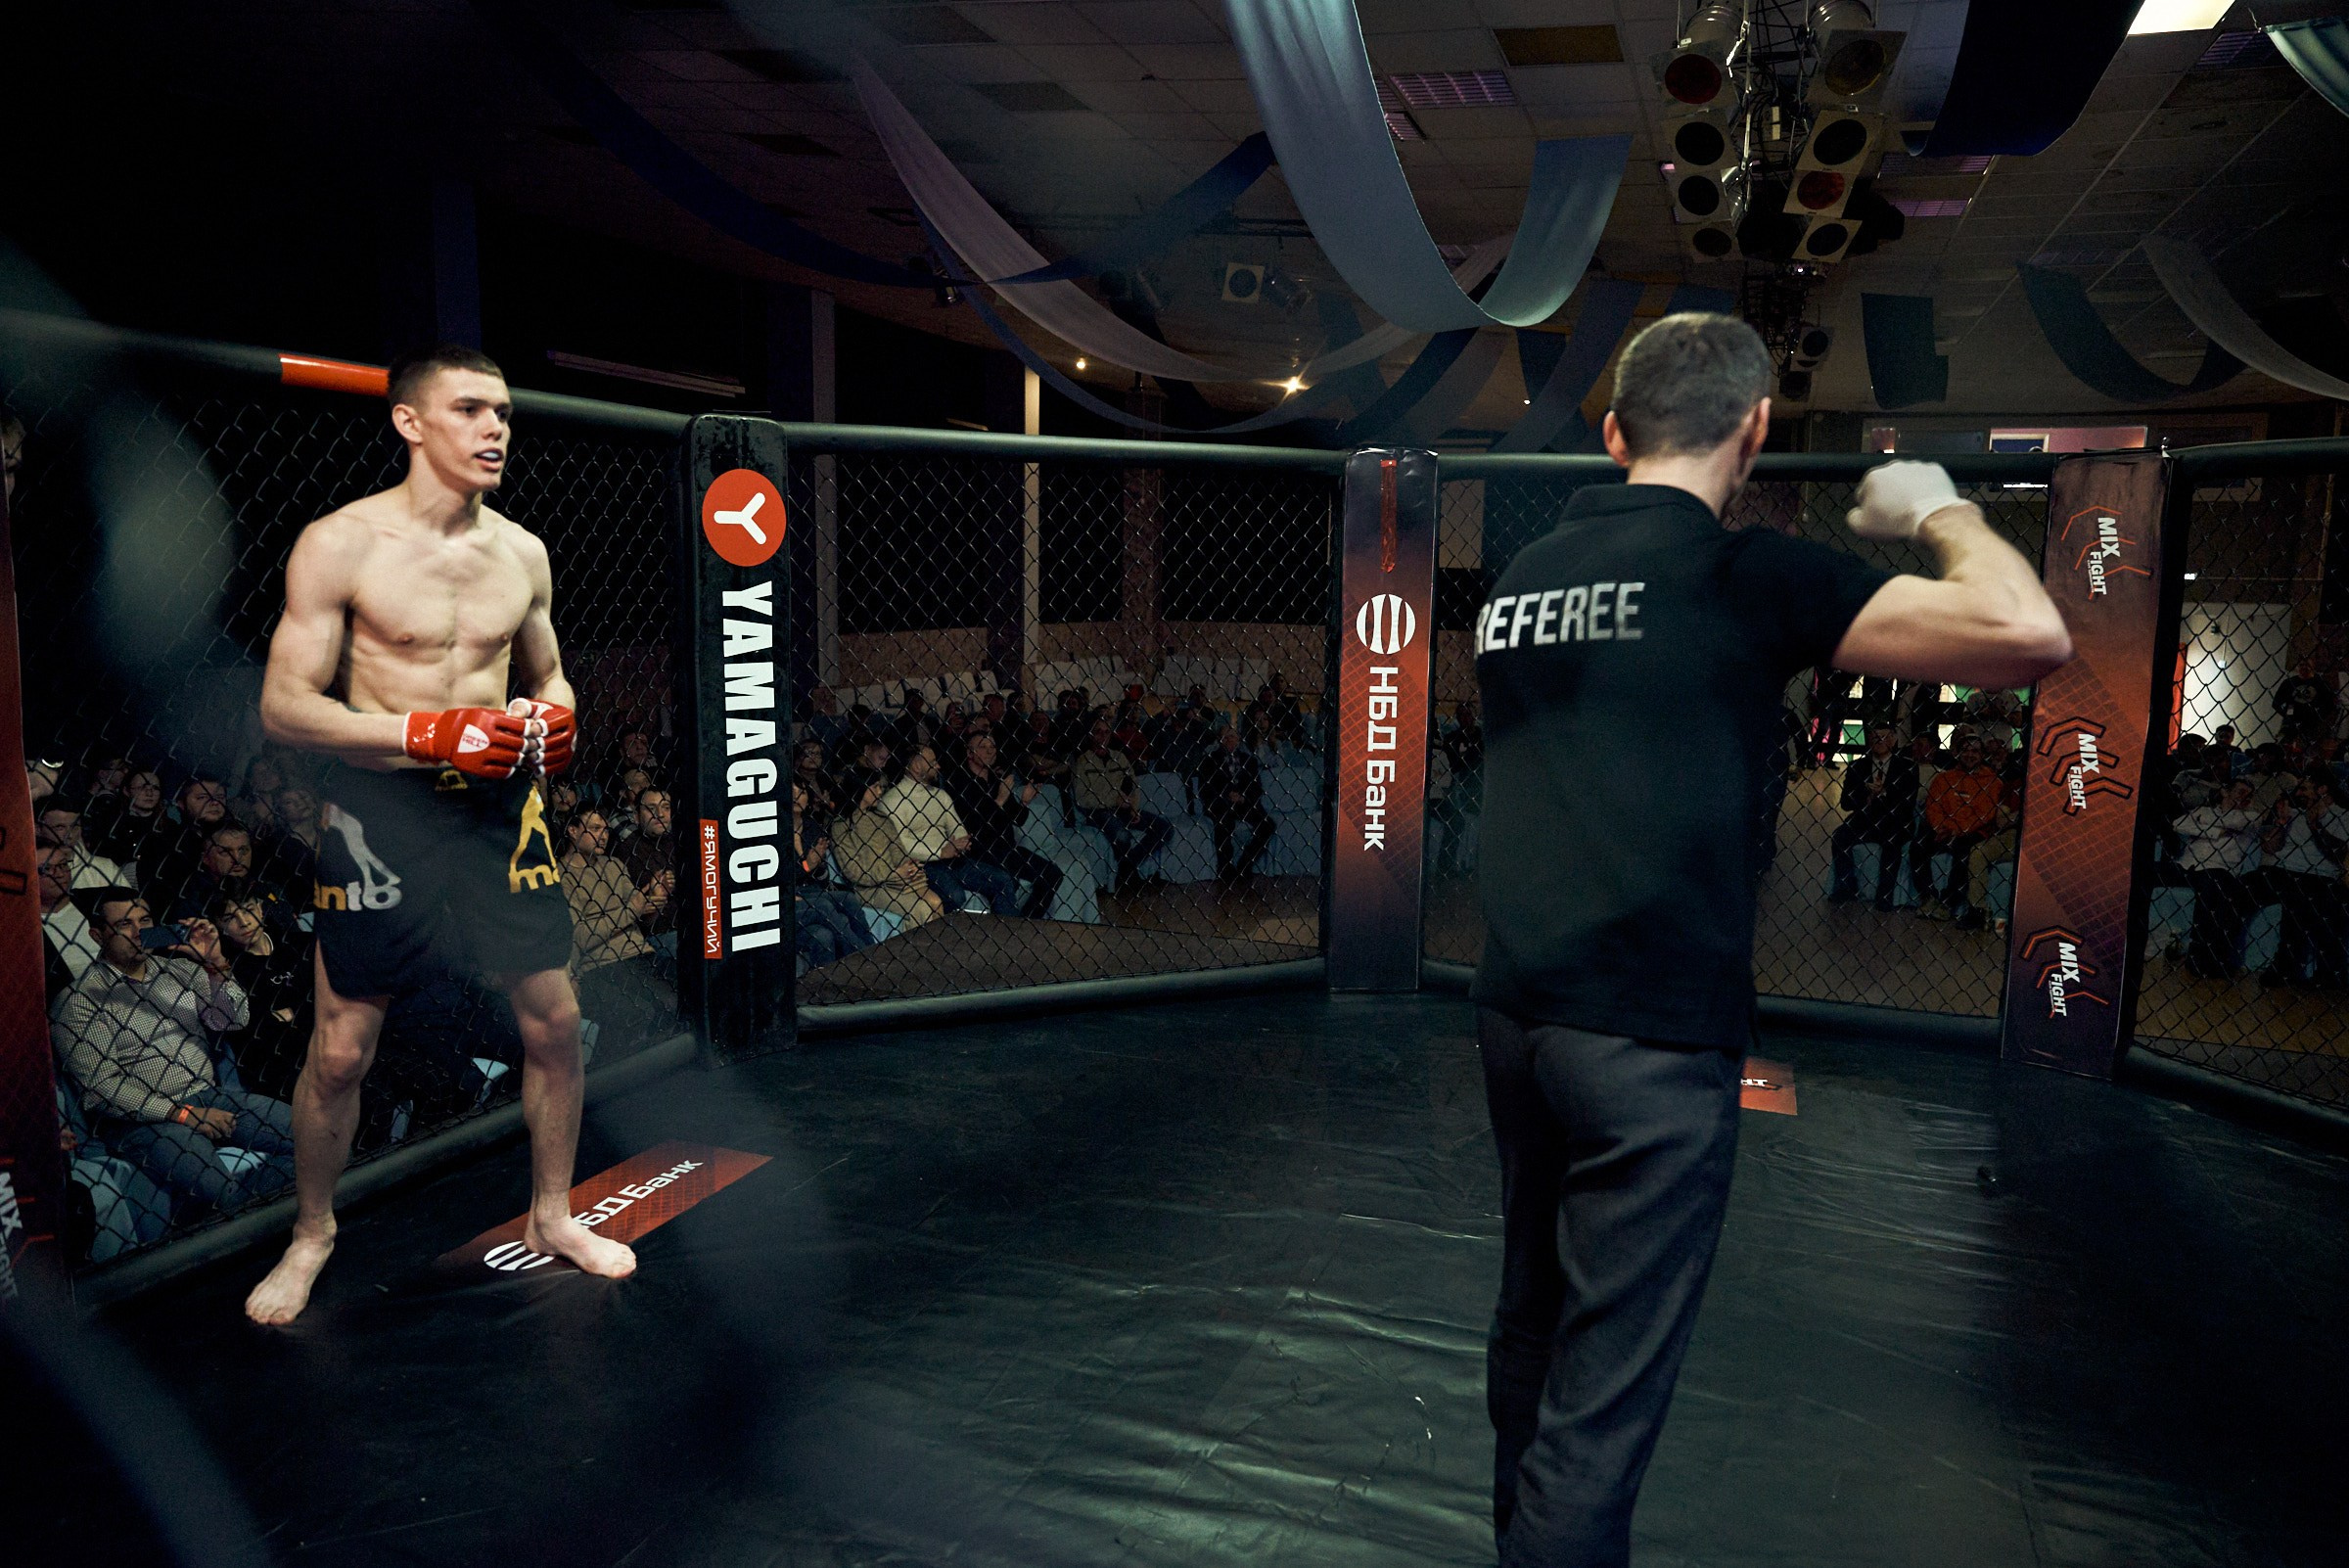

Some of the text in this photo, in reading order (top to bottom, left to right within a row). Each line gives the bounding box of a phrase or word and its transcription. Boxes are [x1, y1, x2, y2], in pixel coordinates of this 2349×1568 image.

[714, 492, 766, 545] Y
[2097, 517, 2121, 558] MIX
[2090, 551, 2107, 595] FIGHT
[1474, 580, 1645, 661] REFEREE
[722, 580, 781, 952] YAMAGUCHI
[1363, 667, 1399, 852] НБД Банк
[2078, 733, 2100, 774] MIX
[2070, 765, 2087, 809] FIGHT
[704, 825, 720, 953] #ЯМОГУЧИЙ
[2058, 942, 2081, 984] MIX
[2050, 973, 2067, 1017] FIGHT
[572, 1160, 704, 1229] БД Банк
